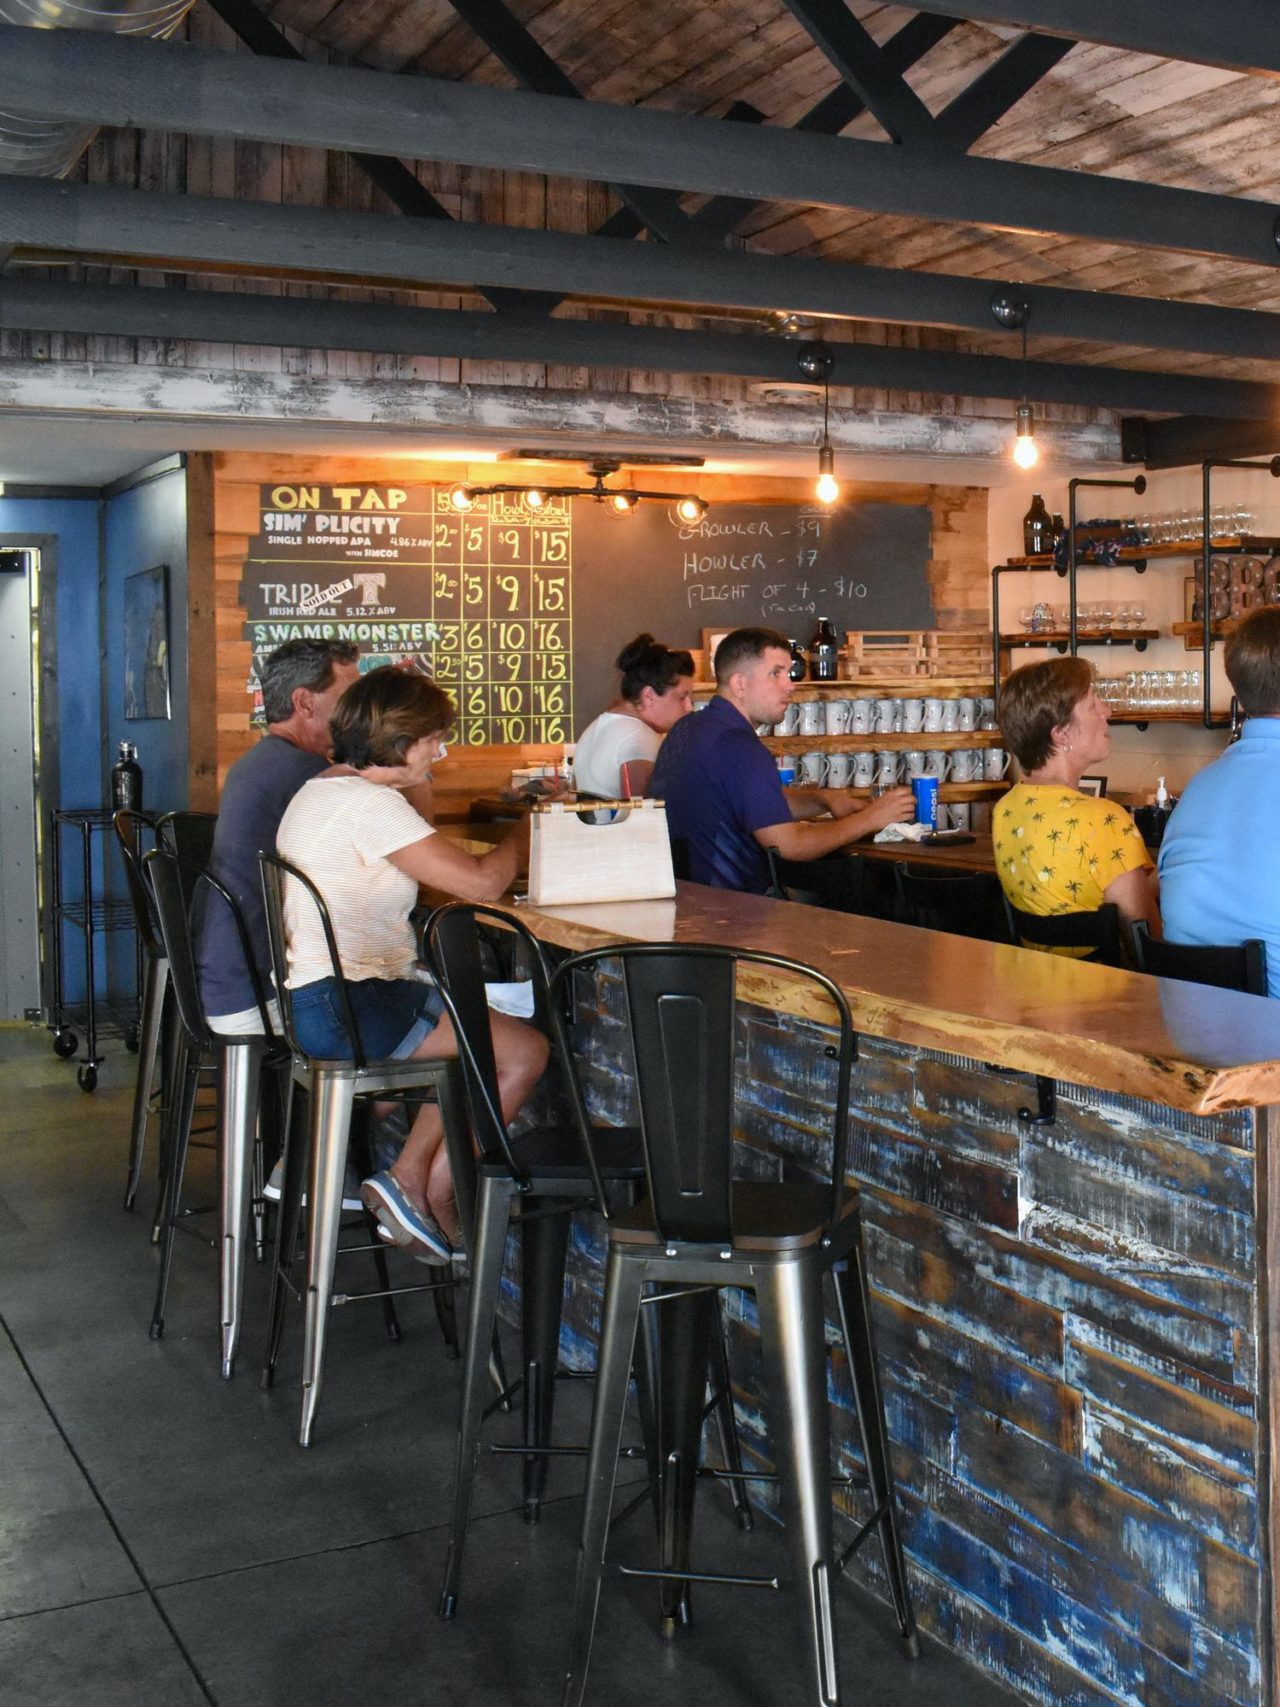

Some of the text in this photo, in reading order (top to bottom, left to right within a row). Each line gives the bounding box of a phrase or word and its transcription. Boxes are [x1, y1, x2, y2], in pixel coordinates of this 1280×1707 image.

[272, 486, 407, 509] ON TAP
[315, 515, 400, 534] PLICITY
[678, 521, 773, 540] GROWLER
[797, 520, 820, 538] $9
[268, 536, 302, 545] SINGLE
[307, 536, 348, 545] HOPPED
[350, 537, 371, 546] APA
[364, 548, 399, 558] SIMCOE
[684, 552, 766, 580] HOWLER
[797, 549, 818, 567] $7
[302, 581, 348, 609] SOLD OUT
[353, 573, 386, 605] T
[687, 584, 751, 609] FLIGHT
[762, 584, 787, 599] OF
[796, 582, 810, 599] 4
[834, 576, 867, 598] $10
[269, 607, 294, 616] IRISH
[296, 607, 316, 616] RED
[318, 608, 337, 616] ALE
[377, 606, 396, 615] ABV
[254, 622, 440, 643] SWAMP MONSTER
[399, 642, 422, 651] ABV
